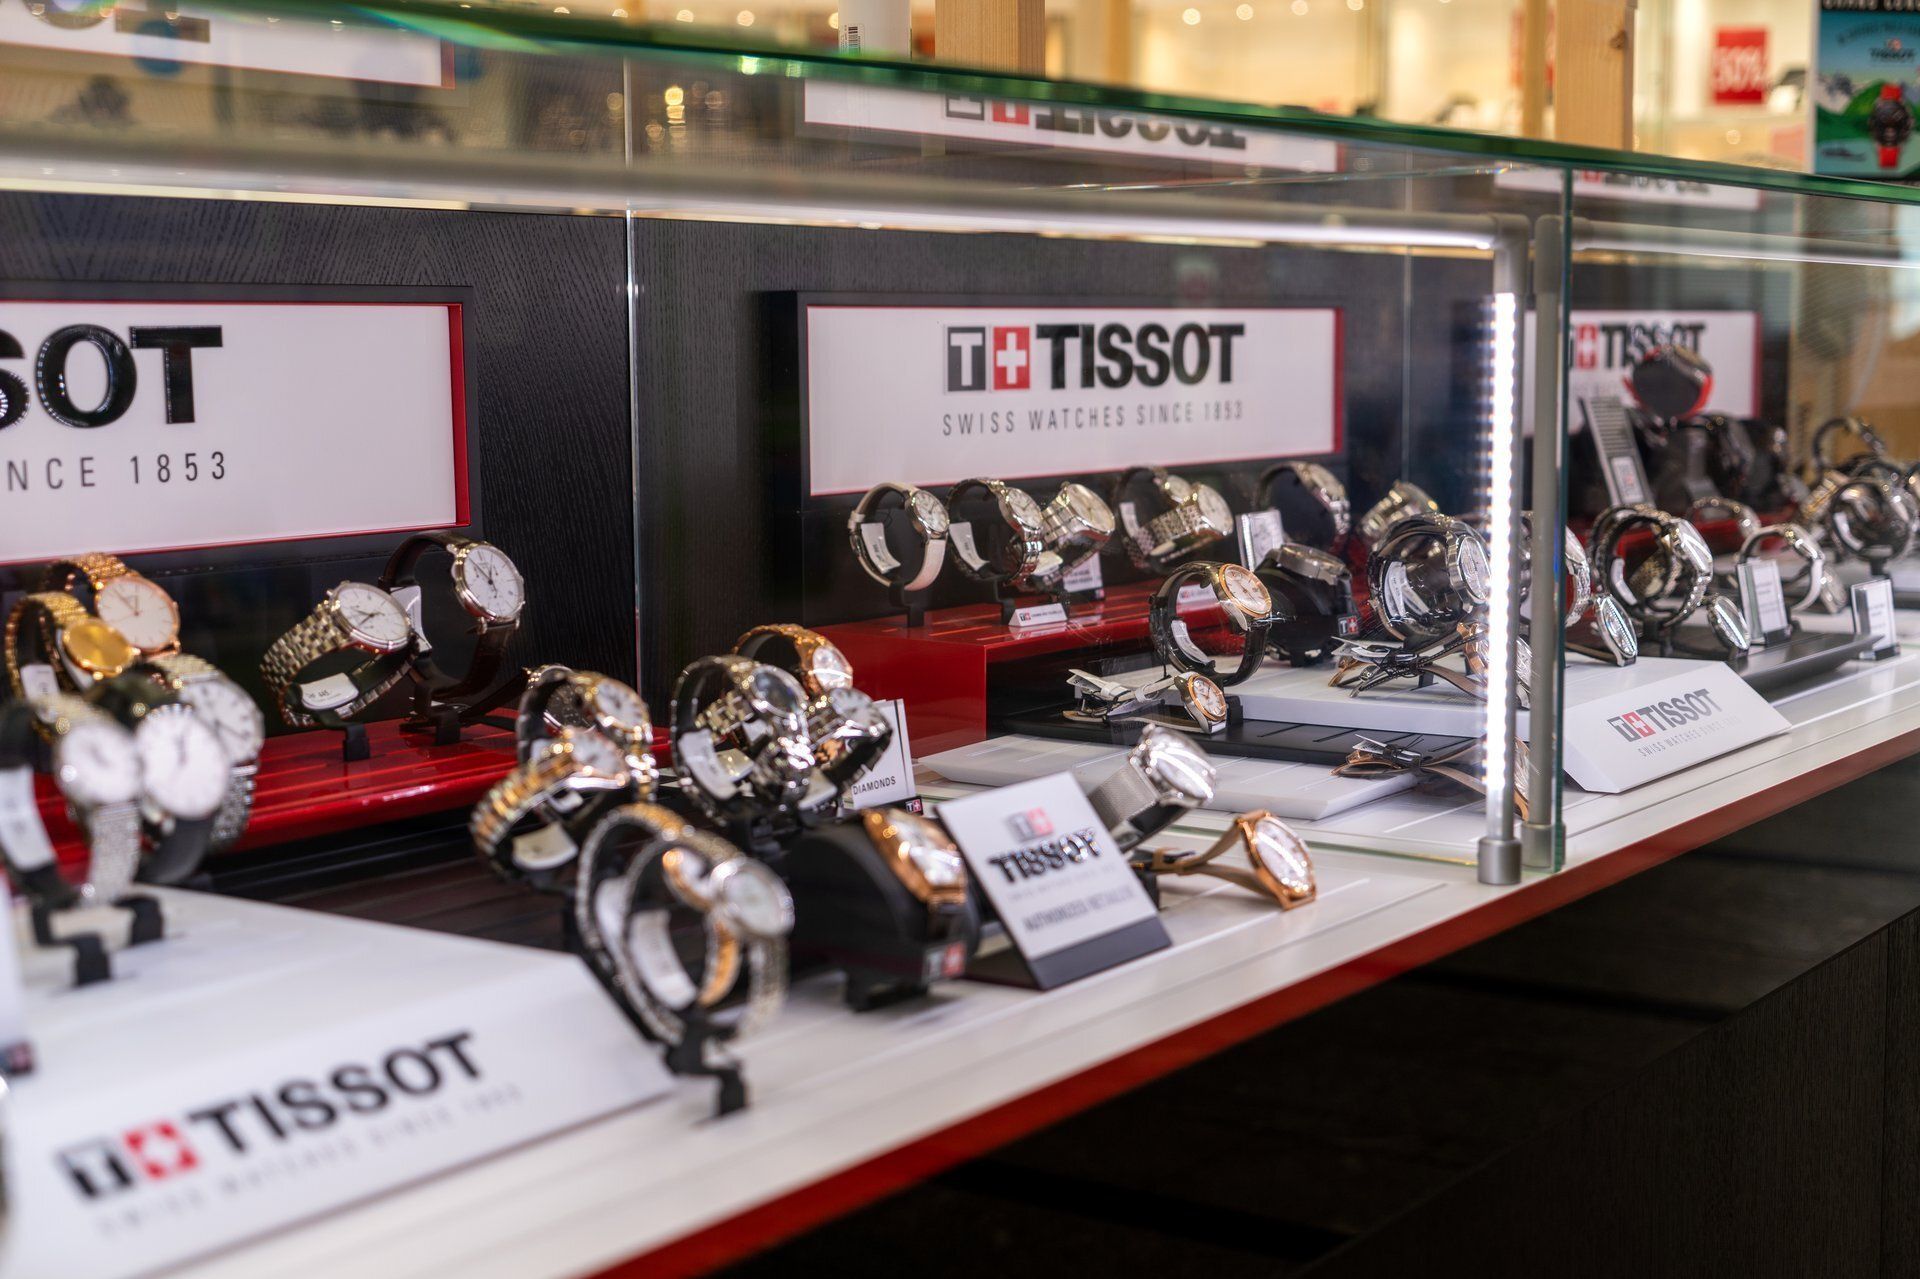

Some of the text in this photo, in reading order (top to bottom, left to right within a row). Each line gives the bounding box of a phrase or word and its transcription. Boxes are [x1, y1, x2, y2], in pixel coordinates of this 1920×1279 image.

[1036, 322, 1245, 389] TISSOT
[942, 400, 1243, 436] SWISS WATCHES SINCE 1853
[129, 450, 226, 484] 1853
[1635, 688, 1722, 731] TISSOT
[852, 775, 897, 795] DIAMONDS
[987, 827, 1101, 884] TISSOT
[186, 1028, 483, 1155] TISSOT
